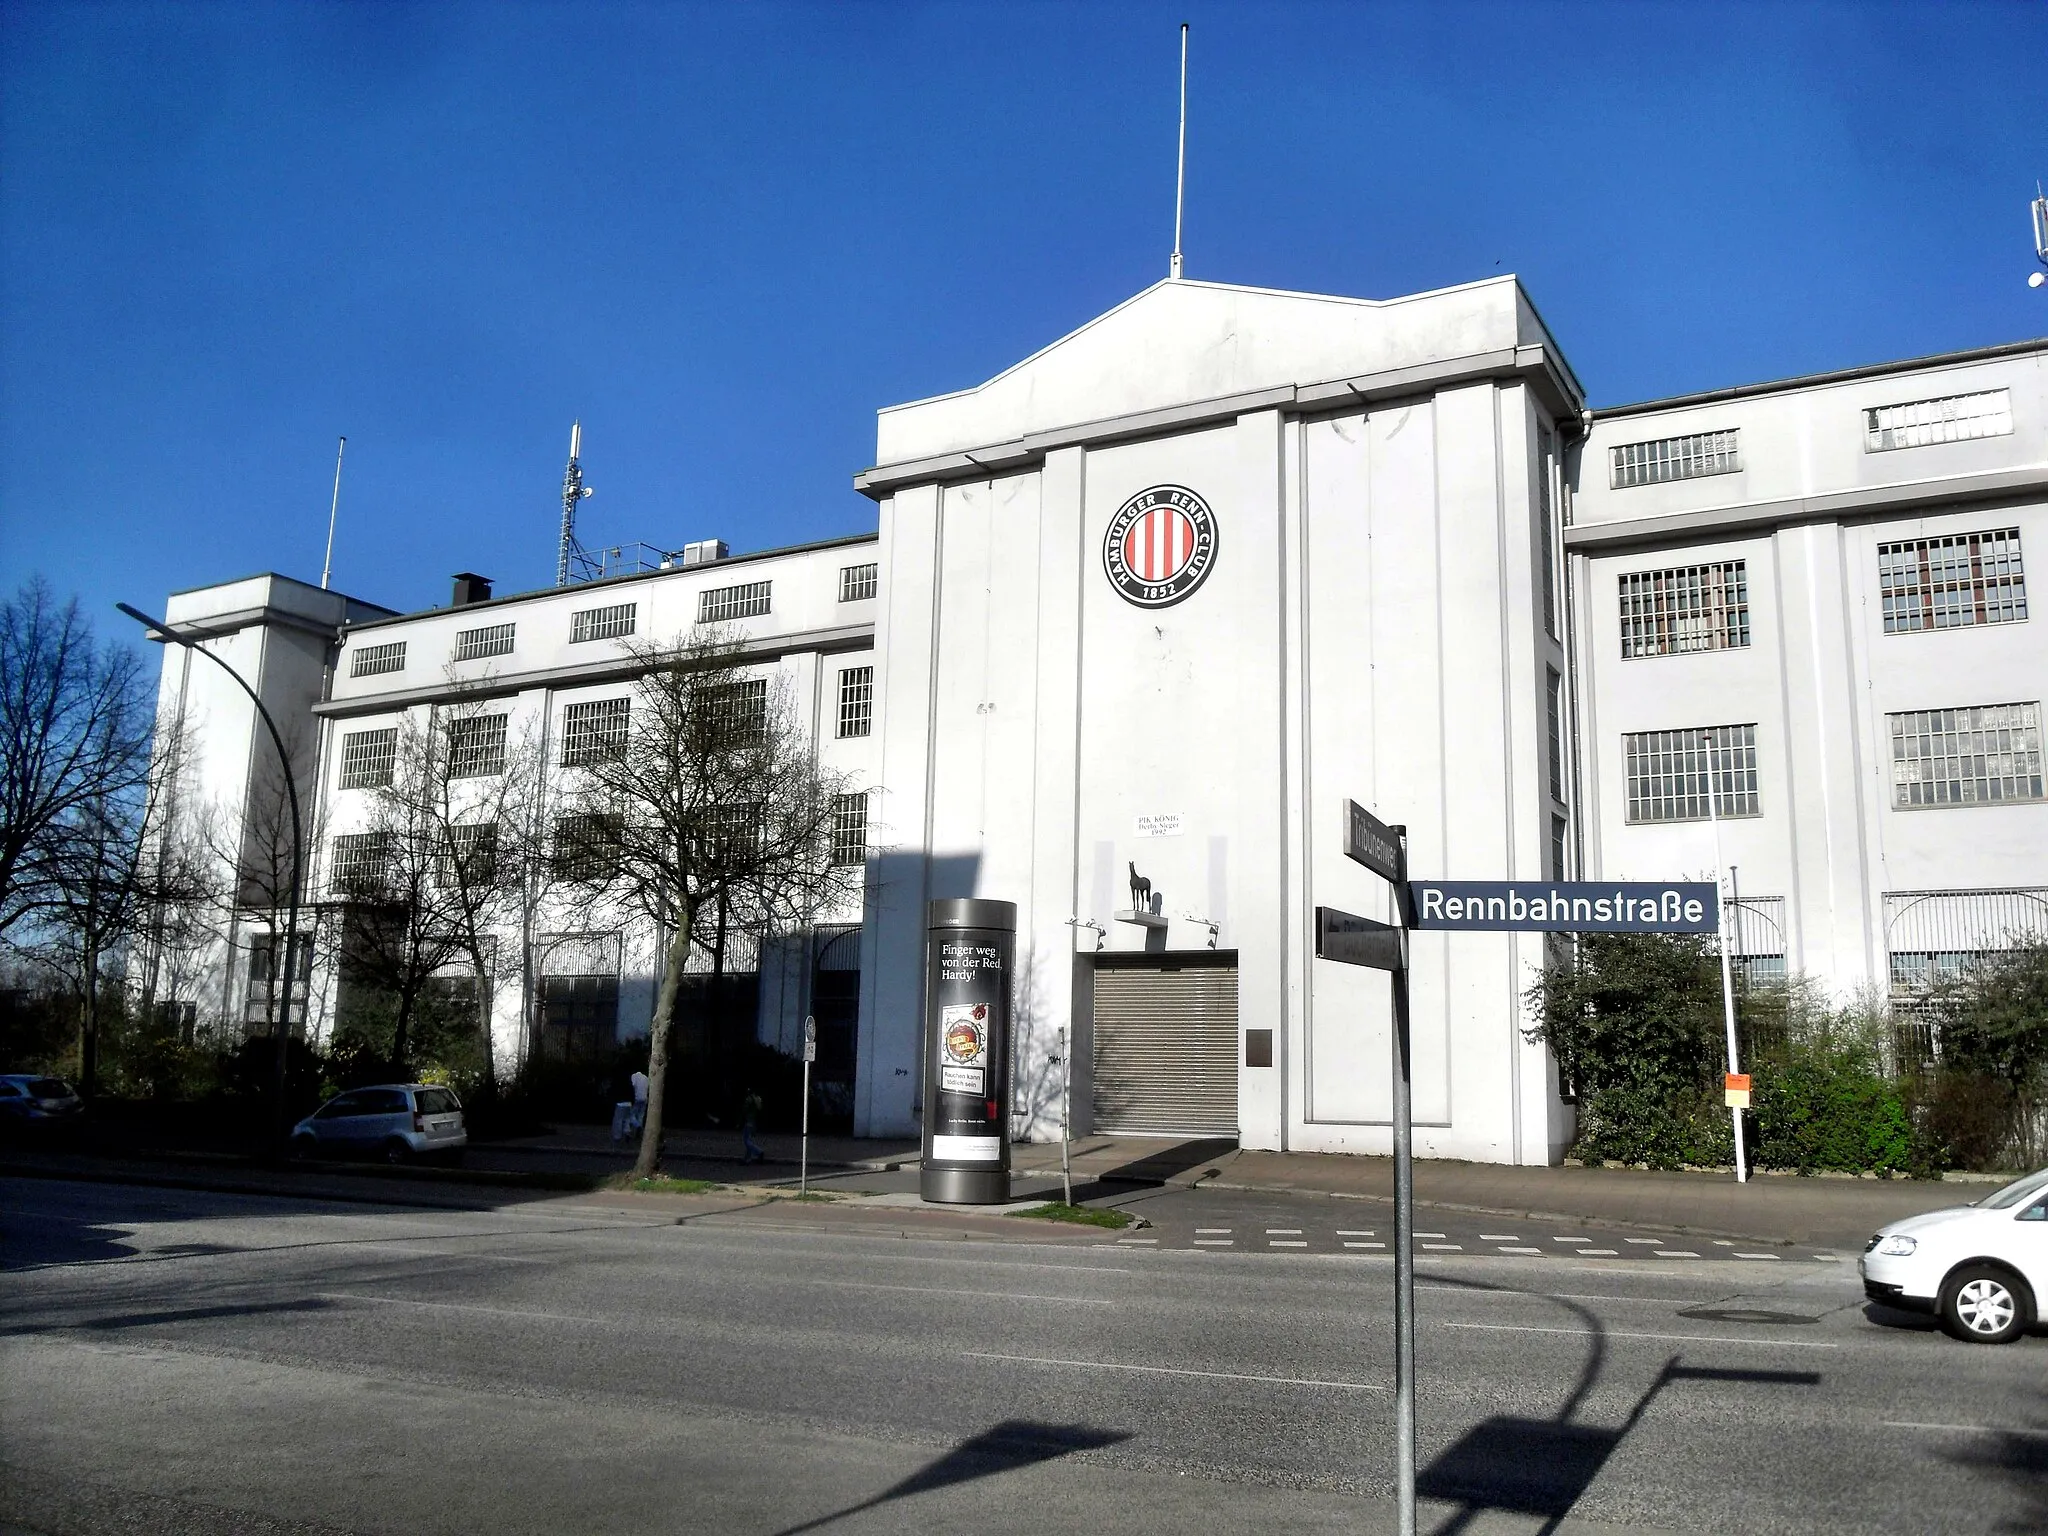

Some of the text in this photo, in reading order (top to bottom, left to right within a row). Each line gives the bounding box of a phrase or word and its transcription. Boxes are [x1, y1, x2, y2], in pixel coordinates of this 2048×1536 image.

[1109, 492, 1211, 586] HAMBURGER RENN-CLUB
[1143, 583, 1176, 598] 1852
[1154, 814, 1179, 823] KÖNIG
[1354, 812, 1397, 878] Tribünenweg
[1421, 888, 1704, 923] Rennbahnstraße
[942, 944, 996, 958] Finger weg
[942, 957, 1002, 971] von der Red,
[942, 969, 976, 982] Hardy!
[944, 1071, 981, 1081] Rauchen kann
